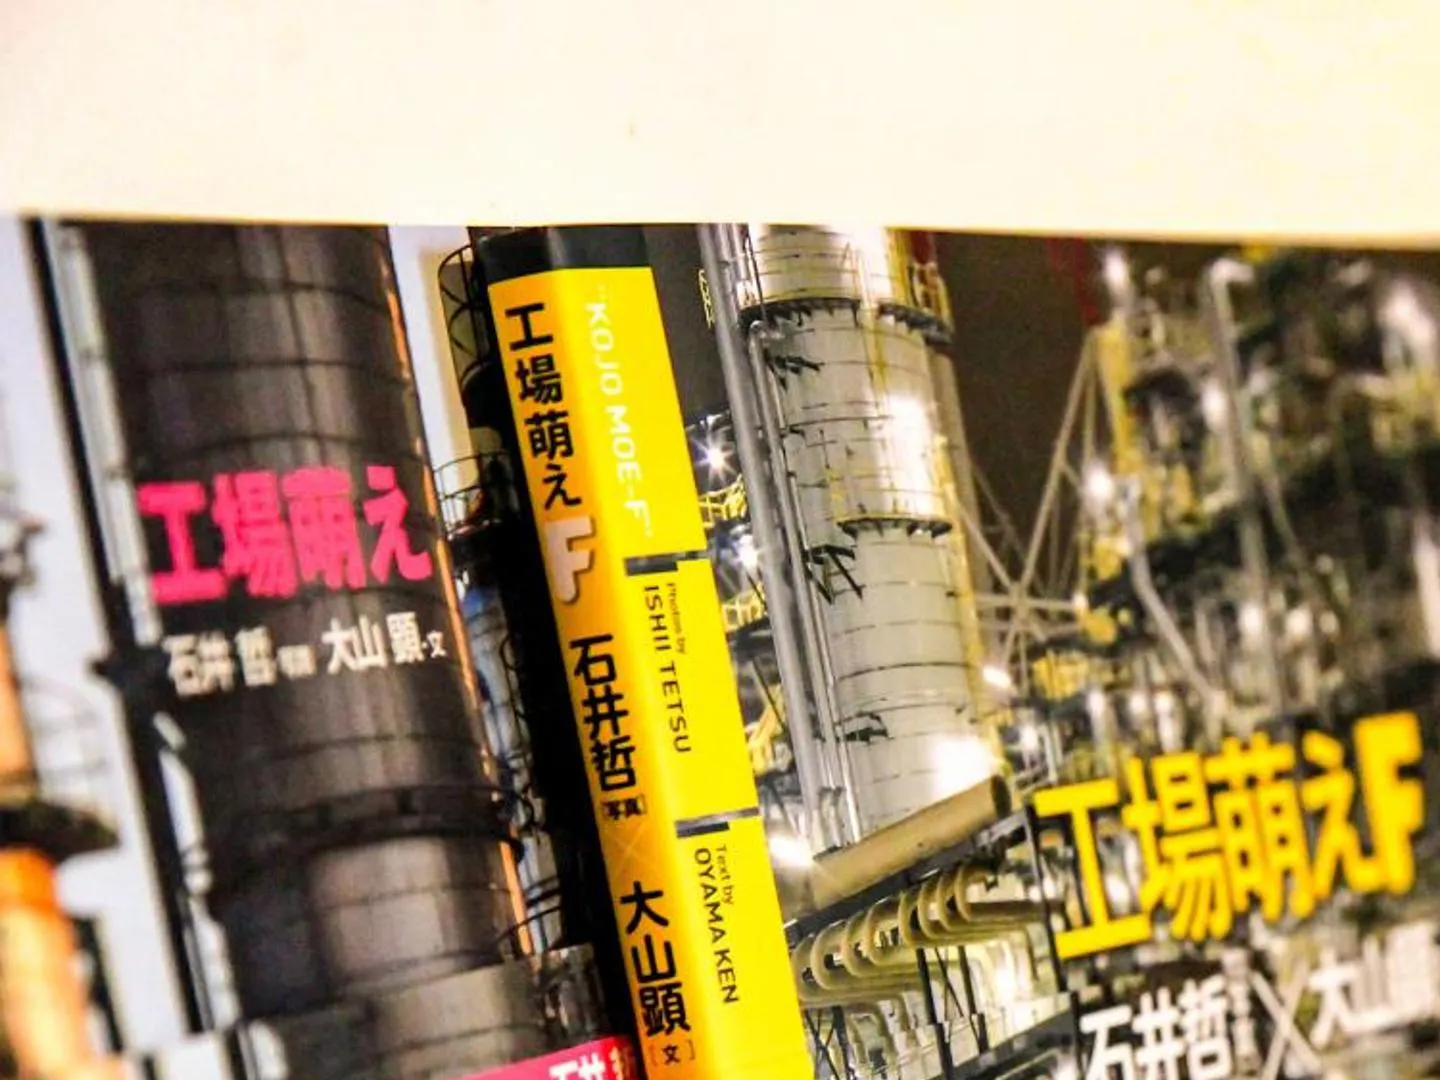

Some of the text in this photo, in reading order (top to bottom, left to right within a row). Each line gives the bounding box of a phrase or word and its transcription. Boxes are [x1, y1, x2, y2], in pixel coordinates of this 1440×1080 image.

[137, 465, 434, 604] 工場萌え
[569, 632, 637, 792] 石井哲
[643, 584, 692, 753] ISHII TETSU
[693, 846, 740, 1005] OYAMA KEN
[716, 843, 734, 906] Text by
[619, 880, 691, 1037] 大山顕
